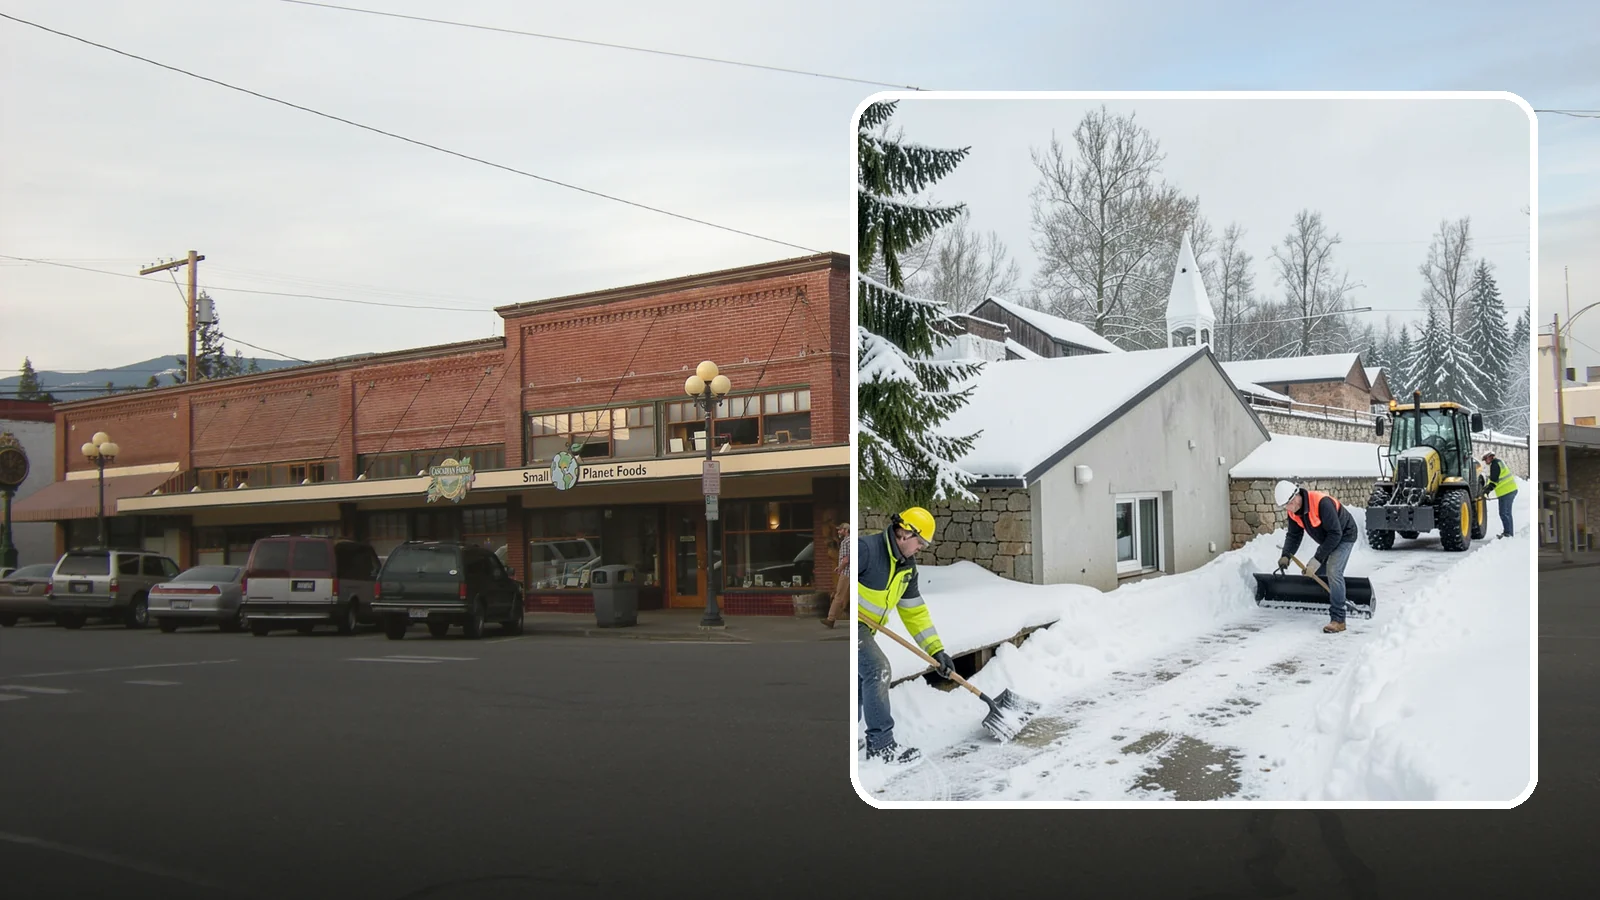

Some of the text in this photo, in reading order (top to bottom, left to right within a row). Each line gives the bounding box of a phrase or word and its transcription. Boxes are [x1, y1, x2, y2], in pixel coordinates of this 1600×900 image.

[523, 464, 647, 483] Small Planet Foods
